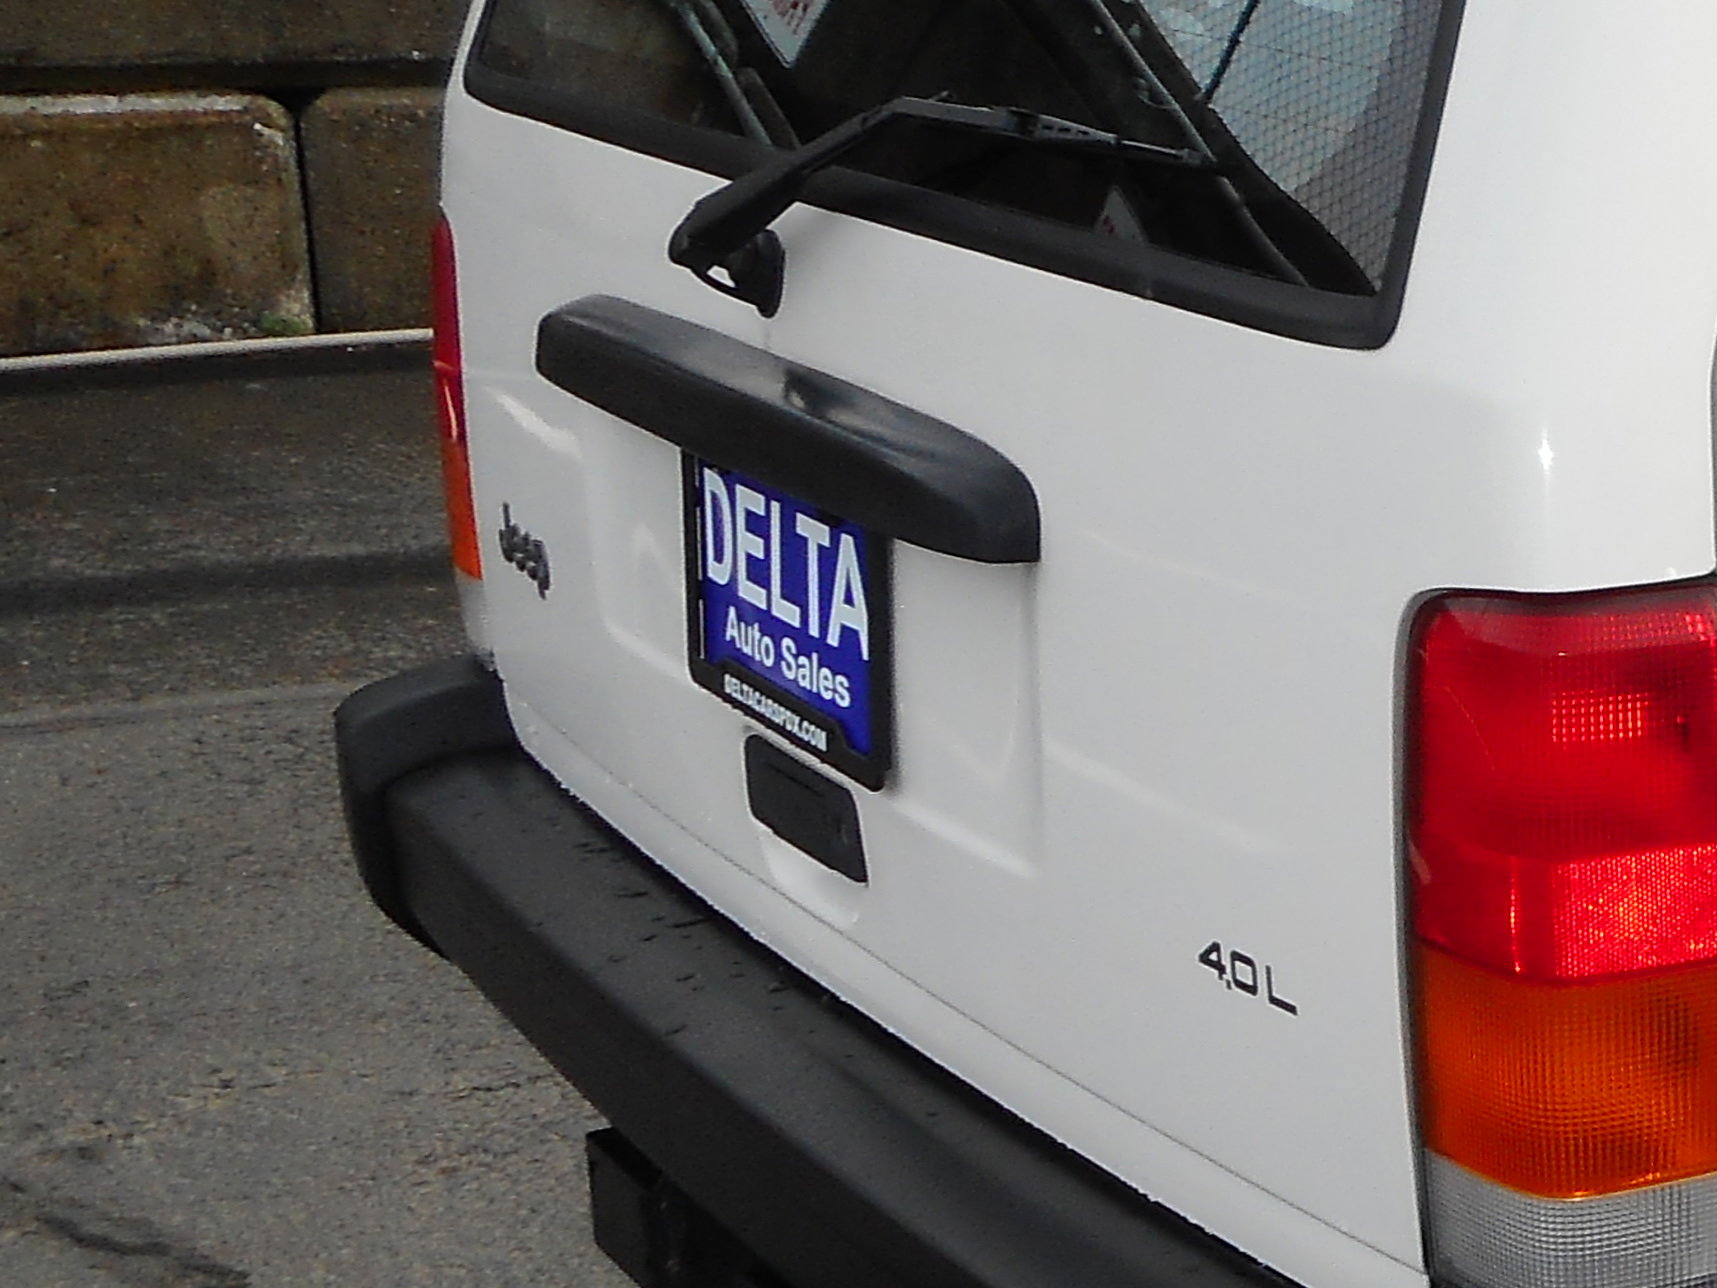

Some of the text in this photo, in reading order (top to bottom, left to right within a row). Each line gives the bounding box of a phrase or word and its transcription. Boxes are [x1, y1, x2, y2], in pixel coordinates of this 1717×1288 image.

[498, 501, 551, 600] Jeep
[703, 466, 870, 661] DELTA
[724, 605, 852, 709] Auto Sales
